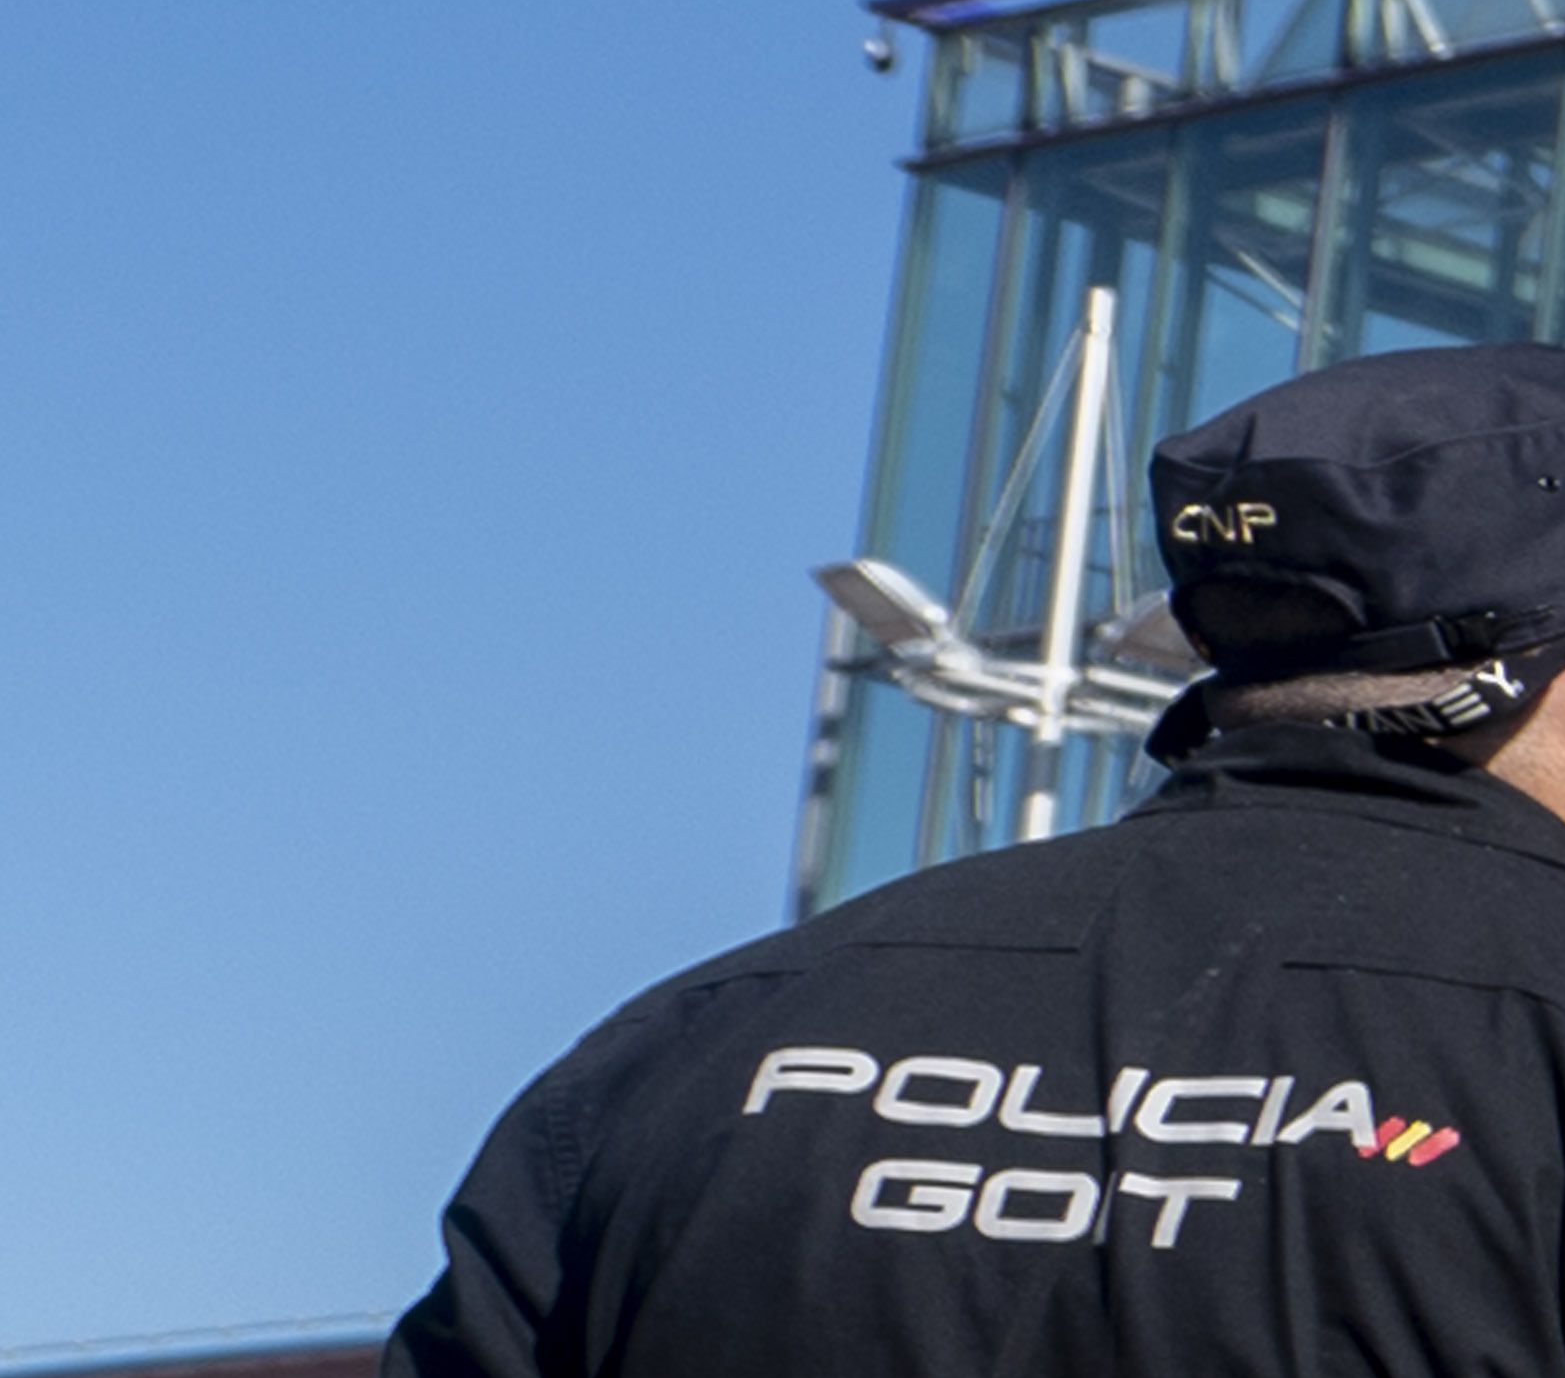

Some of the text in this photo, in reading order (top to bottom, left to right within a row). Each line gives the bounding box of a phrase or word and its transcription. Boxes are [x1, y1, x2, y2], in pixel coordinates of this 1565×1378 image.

[1172, 502, 1278, 543] CNP
[743, 1047, 1377, 1149] POLICIA
[850, 1159, 1243, 1249] GOIT
